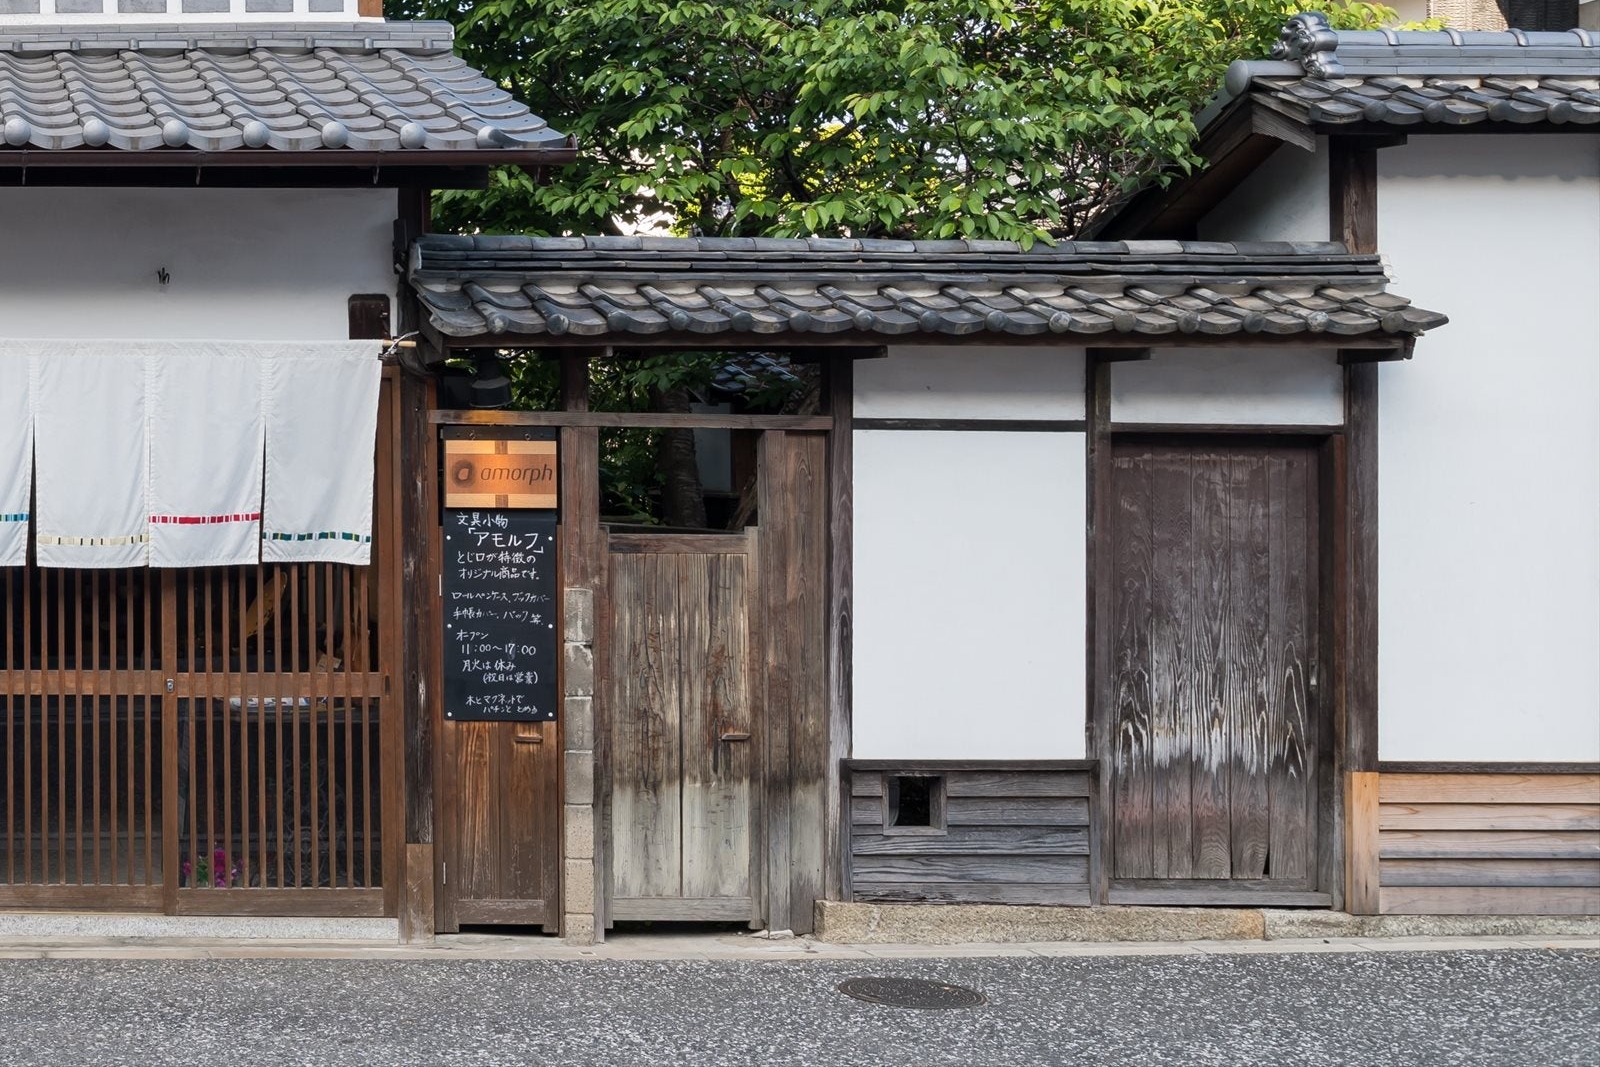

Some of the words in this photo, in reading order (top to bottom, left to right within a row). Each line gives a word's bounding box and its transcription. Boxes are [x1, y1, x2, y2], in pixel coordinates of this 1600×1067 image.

[480, 463, 553, 485] amorph
[456, 512, 509, 529] 文具小物
[468, 527, 544, 553] 「アモルフ」
[456, 629, 489, 641] オープン
